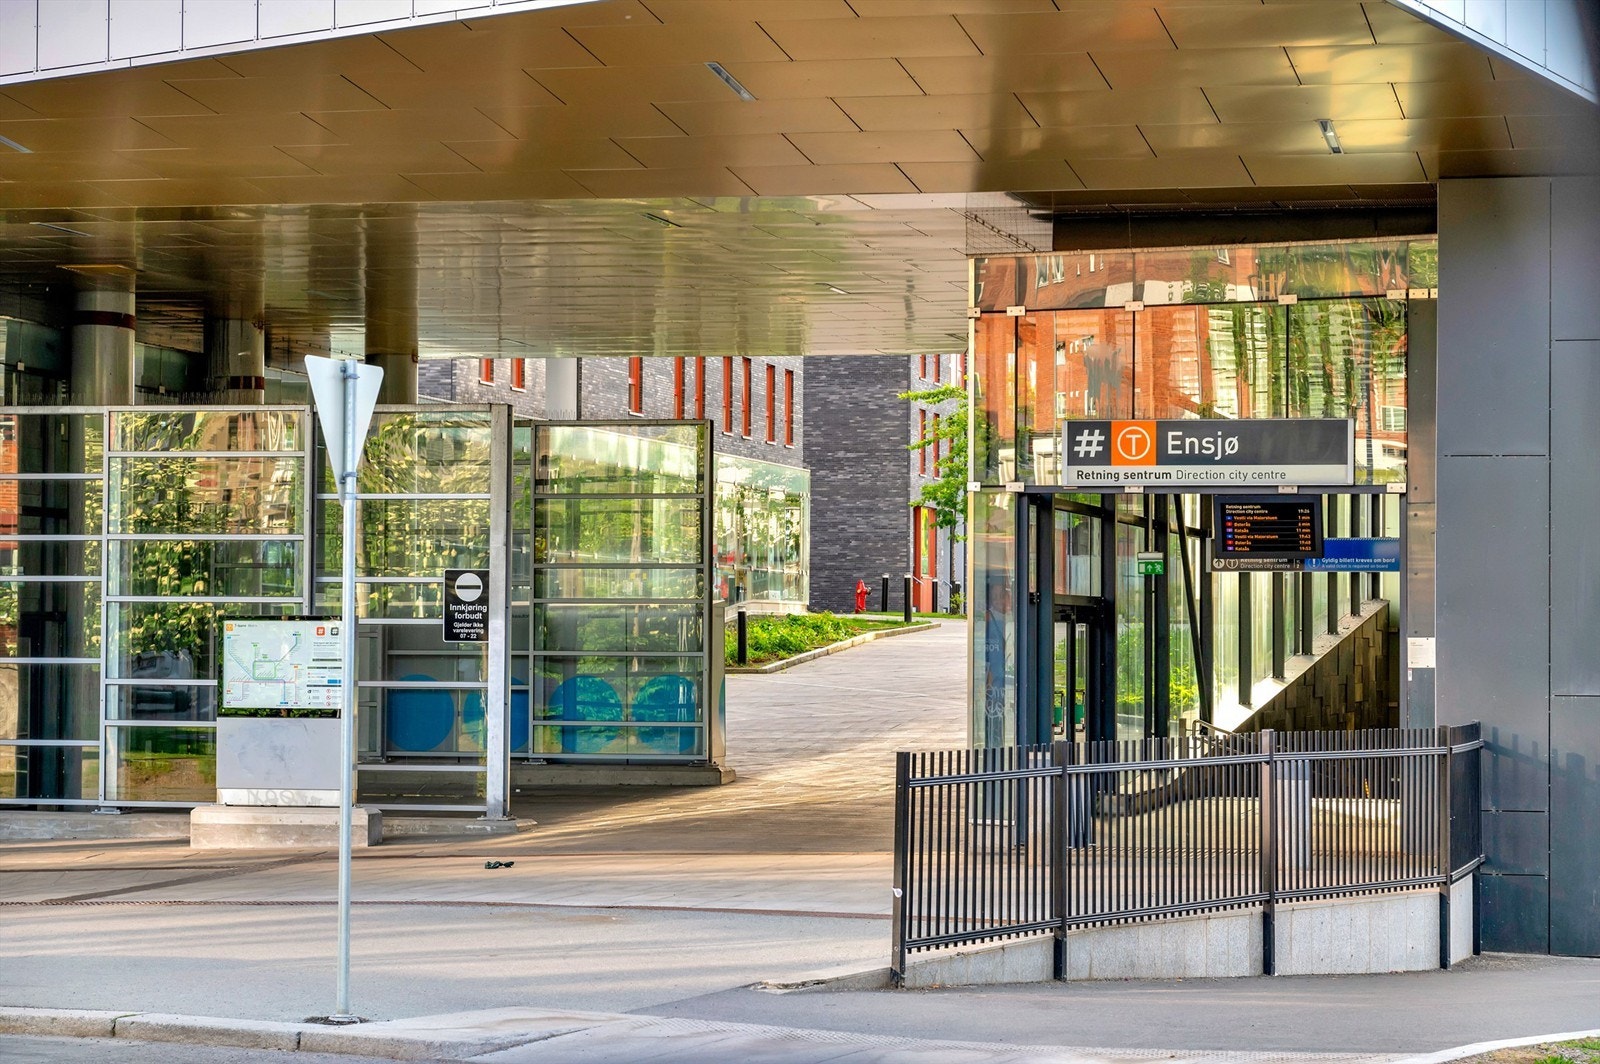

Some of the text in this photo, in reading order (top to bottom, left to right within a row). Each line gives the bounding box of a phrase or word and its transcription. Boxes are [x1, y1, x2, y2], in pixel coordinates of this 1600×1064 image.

[1167, 431, 1239, 460] Ensjø
[1076, 470, 1286, 482] Retning sentrum Direction city centre
[450, 604, 487, 612] Innkjøring
